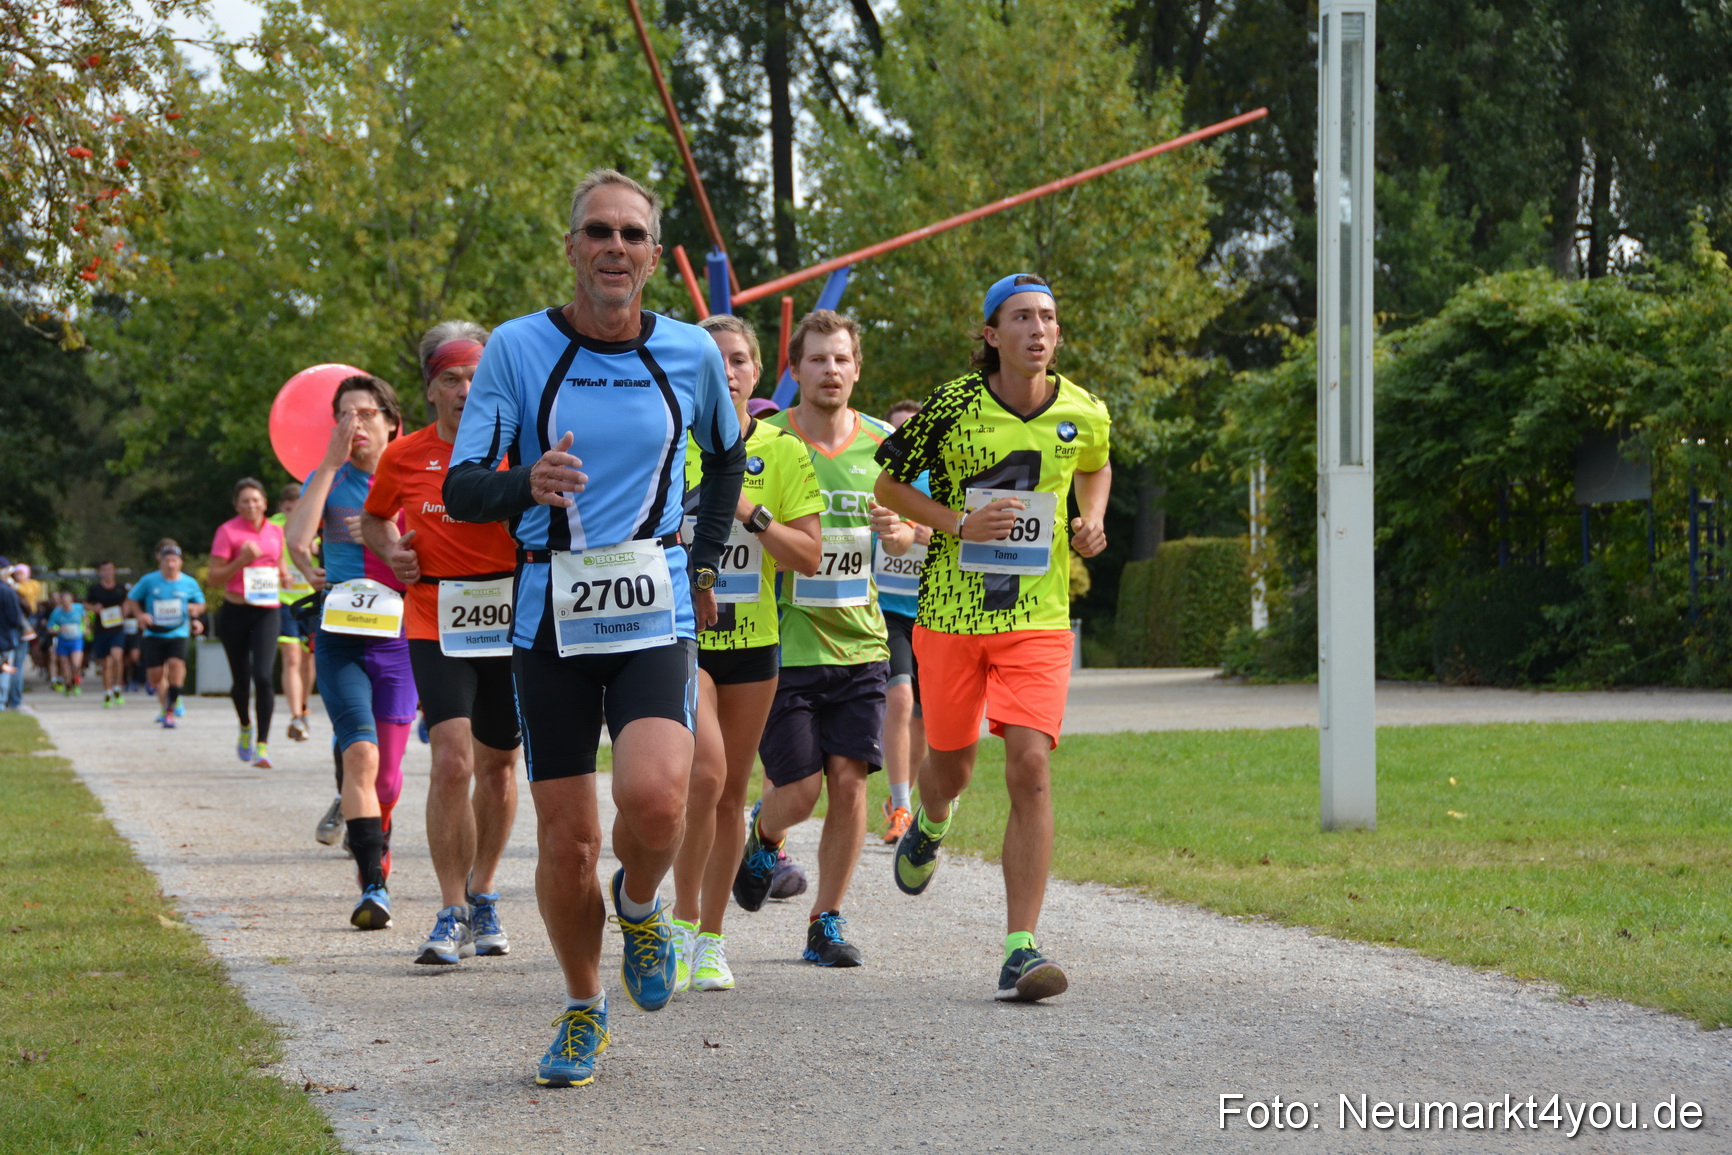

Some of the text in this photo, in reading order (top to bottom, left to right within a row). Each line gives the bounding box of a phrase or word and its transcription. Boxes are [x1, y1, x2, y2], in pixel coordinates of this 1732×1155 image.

[1055, 445, 1077, 455] Partl
[743, 477, 765, 486] Partl
[596, 552, 636, 565] BOCK
[994, 549, 1018, 560] Tamo
[883, 556, 922, 575] 2926
[571, 574, 655, 613] 2700
[351, 593, 379, 609] 37
[346, 614, 378, 624] Gerhard
[451, 603, 513, 628] 2490
[593, 621, 640, 634] Thomas
[465, 634, 501, 644] Hartmut
